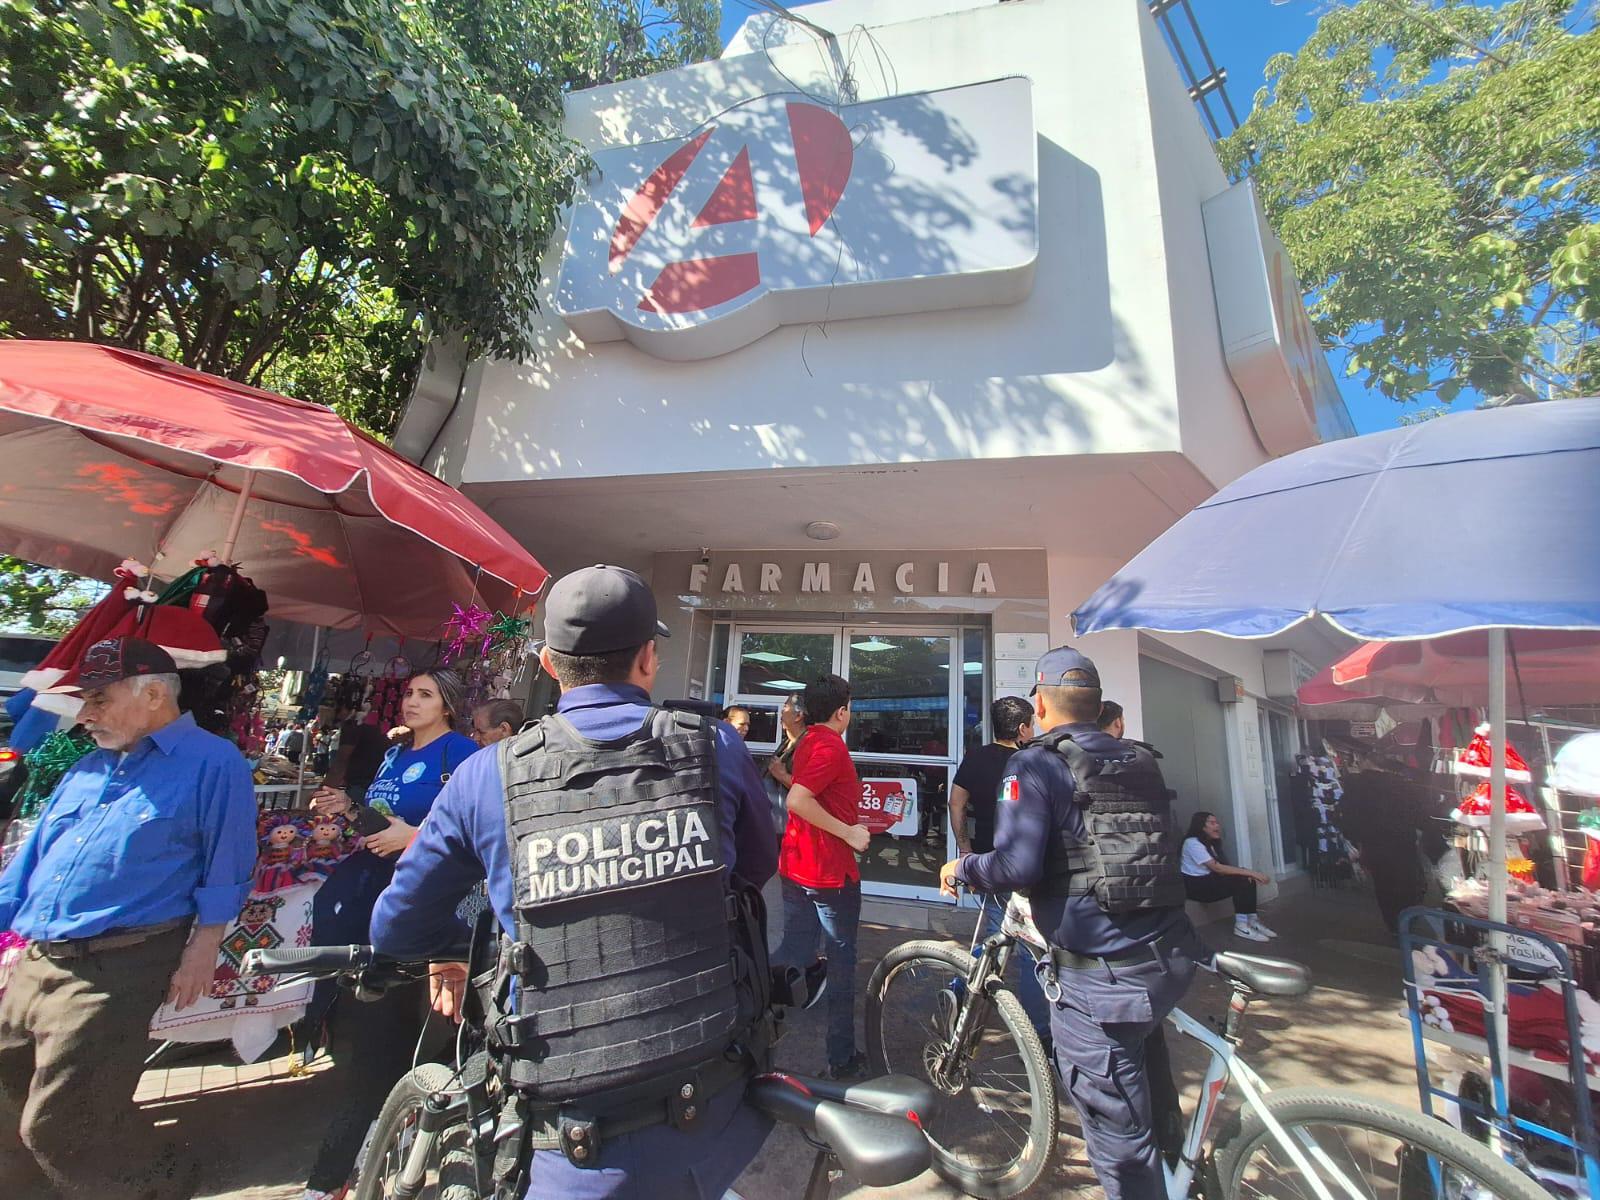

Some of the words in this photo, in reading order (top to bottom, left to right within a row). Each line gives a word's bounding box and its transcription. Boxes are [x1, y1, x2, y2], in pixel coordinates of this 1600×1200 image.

[688, 561, 998, 593] FARMACIA
[528, 809, 711, 874] POLICÍA
[528, 843, 715, 902] MUNICIPAL
